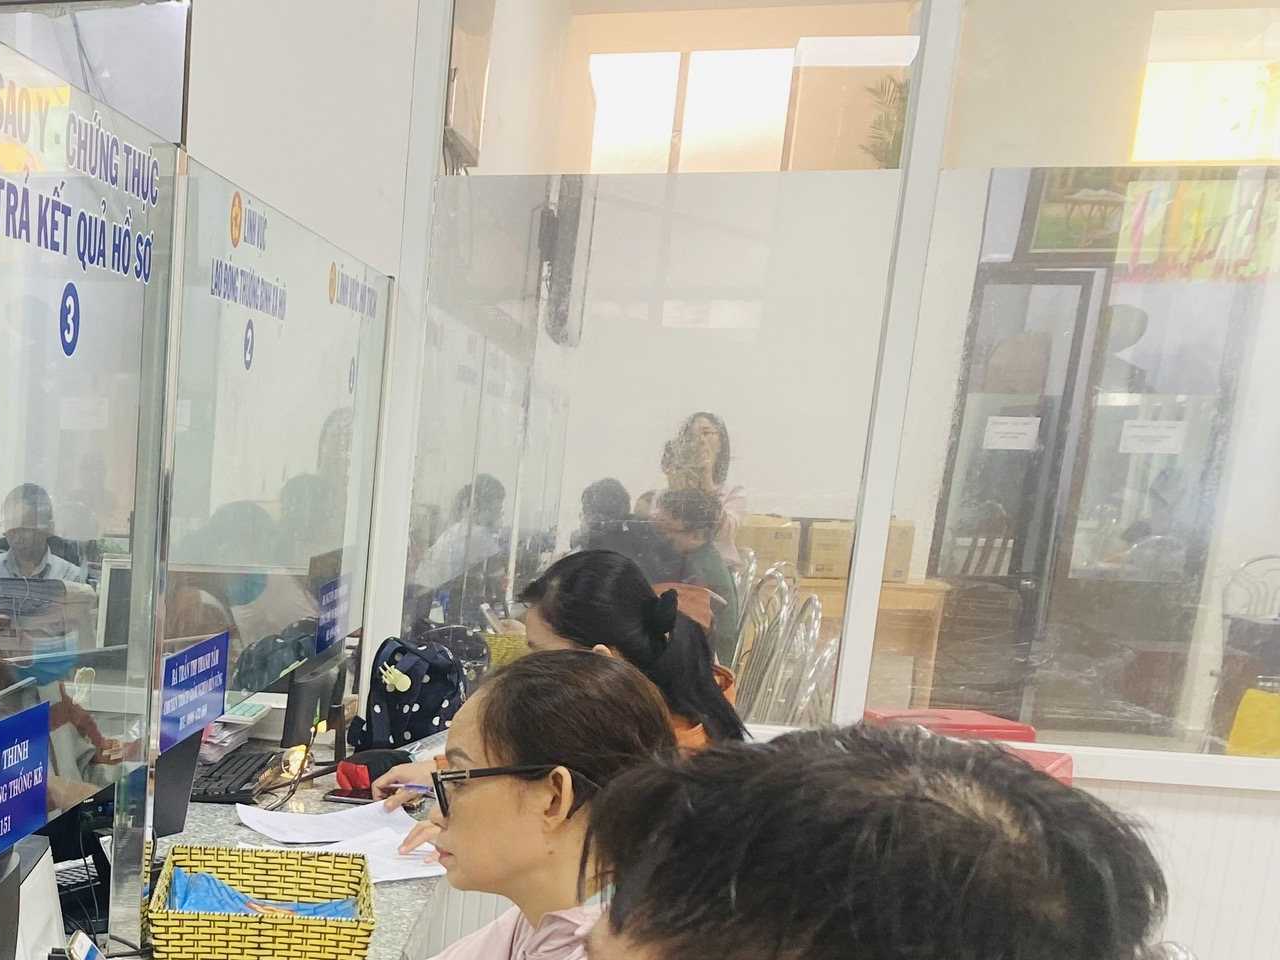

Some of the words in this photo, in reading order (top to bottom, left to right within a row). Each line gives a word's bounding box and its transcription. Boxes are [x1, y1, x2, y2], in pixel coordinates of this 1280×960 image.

[37, 94, 50, 152] Y
[66, 111, 119, 187] CHỨNG
[123, 143, 159, 212] THỰC
[37, 180, 71, 256] KẾT
[77, 199, 106, 271] QUẢ
[112, 206, 132, 275] HỒ
[134, 231, 154, 283] SƠ
[65, 296, 75, 344] 3
[246, 328, 252, 361] 2
[3, 739, 30, 770] THÍNH
[8, 767, 33, 801] THỐNG
[33, 761, 43, 787] KÊ
